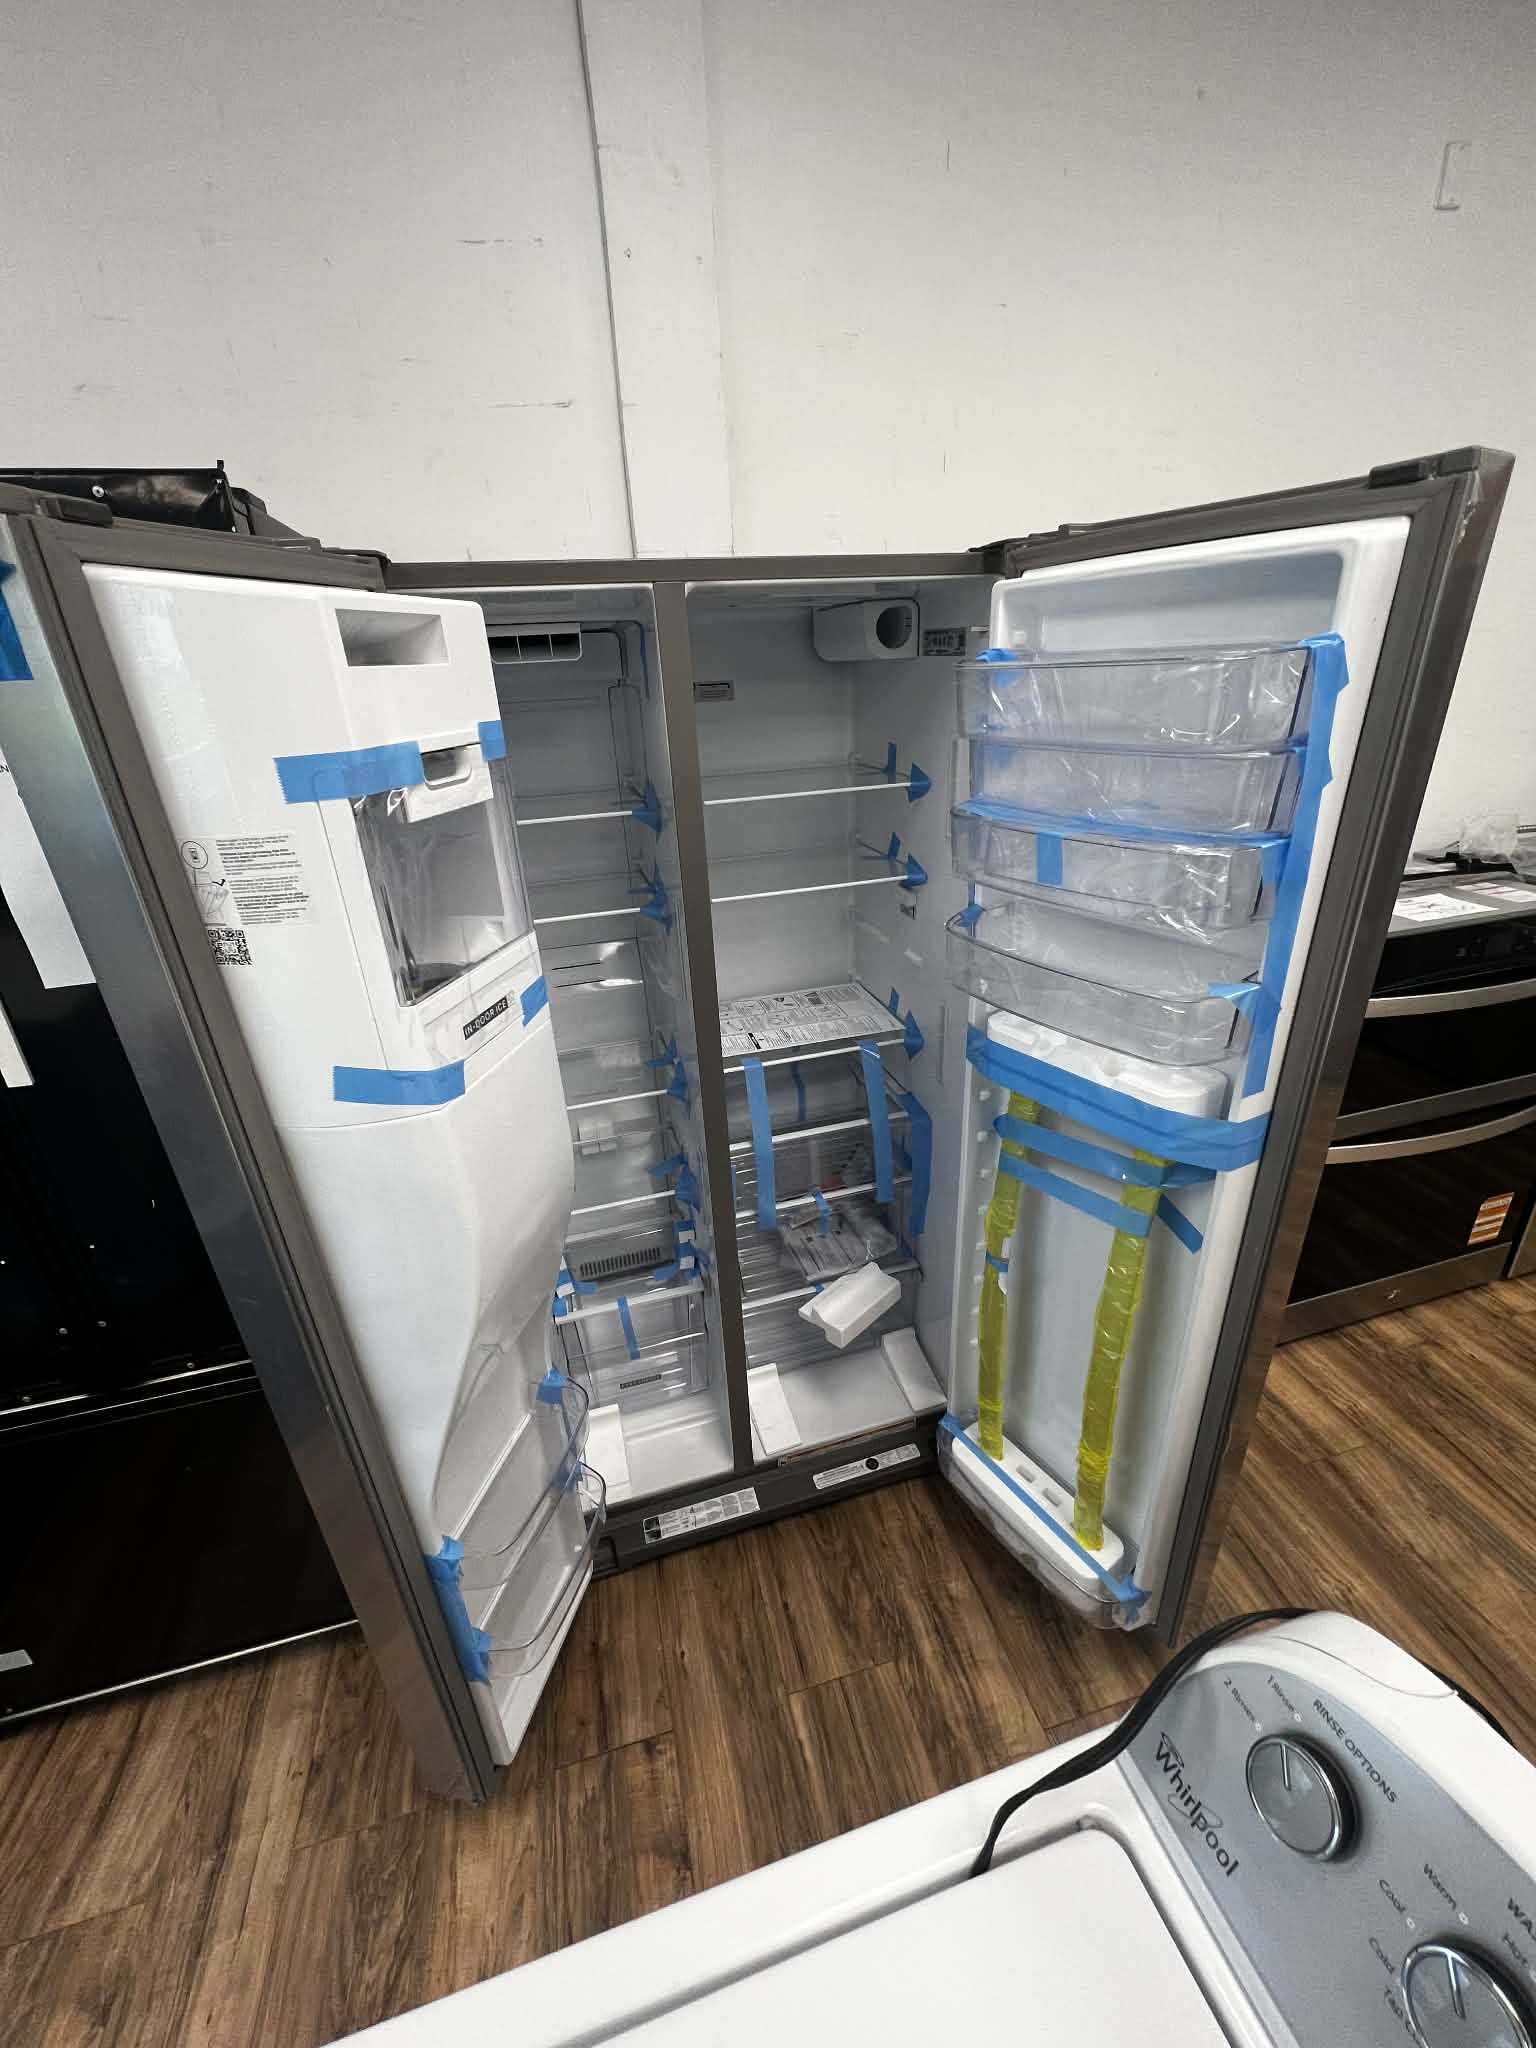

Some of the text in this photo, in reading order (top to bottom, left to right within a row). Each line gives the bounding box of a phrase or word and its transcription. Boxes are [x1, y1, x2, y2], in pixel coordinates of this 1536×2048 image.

[464, 999, 507, 1037] IN-DOOR ICE
[1313, 1698, 1397, 1802] RINSE OPTIONS
[1156, 1740, 1239, 1877] Whirlpool
[1378, 1879, 1406, 1913] Cool
[1423, 1863, 1457, 1911] Warm
[1502, 1933, 1529, 1969] Hot
